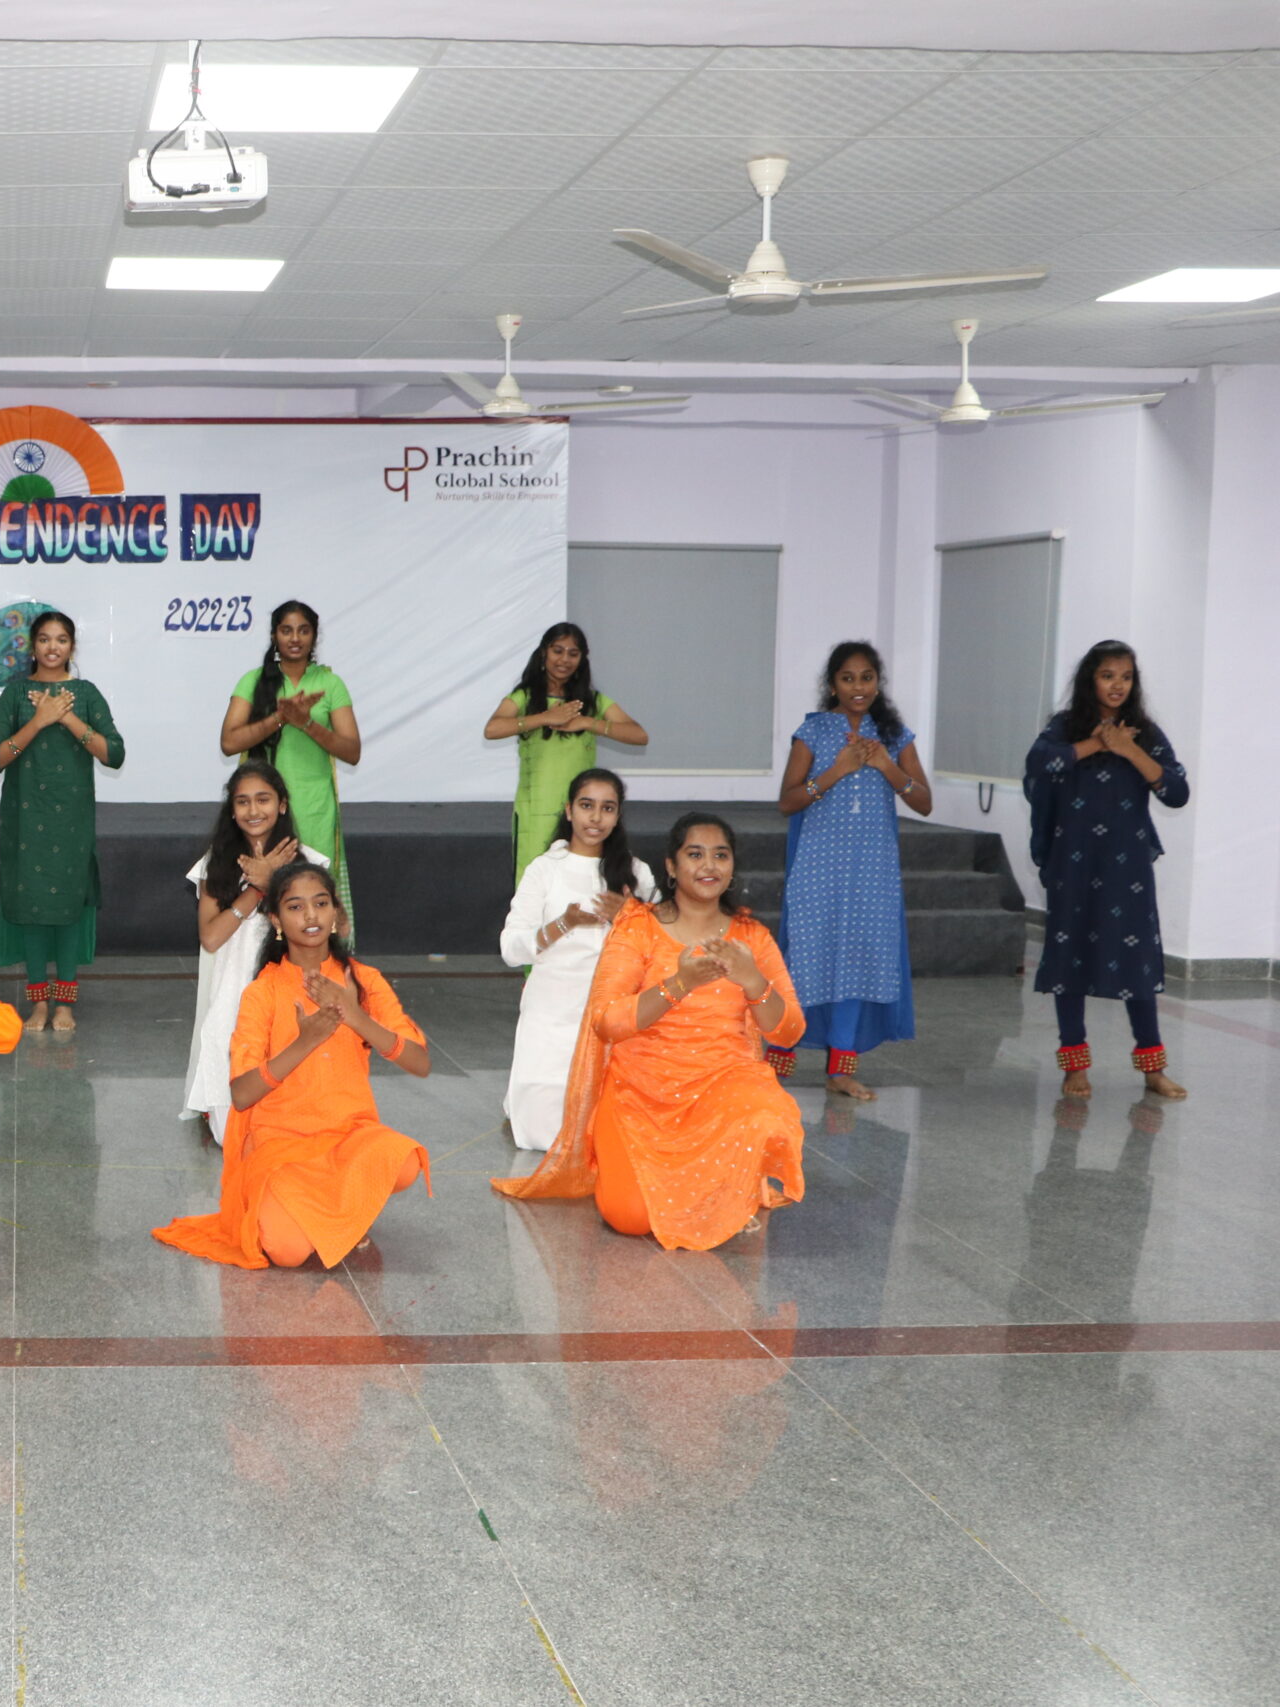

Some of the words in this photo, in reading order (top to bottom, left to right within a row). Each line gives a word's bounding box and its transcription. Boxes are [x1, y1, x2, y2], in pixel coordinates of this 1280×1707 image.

[435, 445, 534, 467] Prachin
[435, 472, 493, 488] Global
[499, 472, 559, 488] School
[192, 502, 257, 554] DAY
[163, 595, 253, 633] 2022-23
